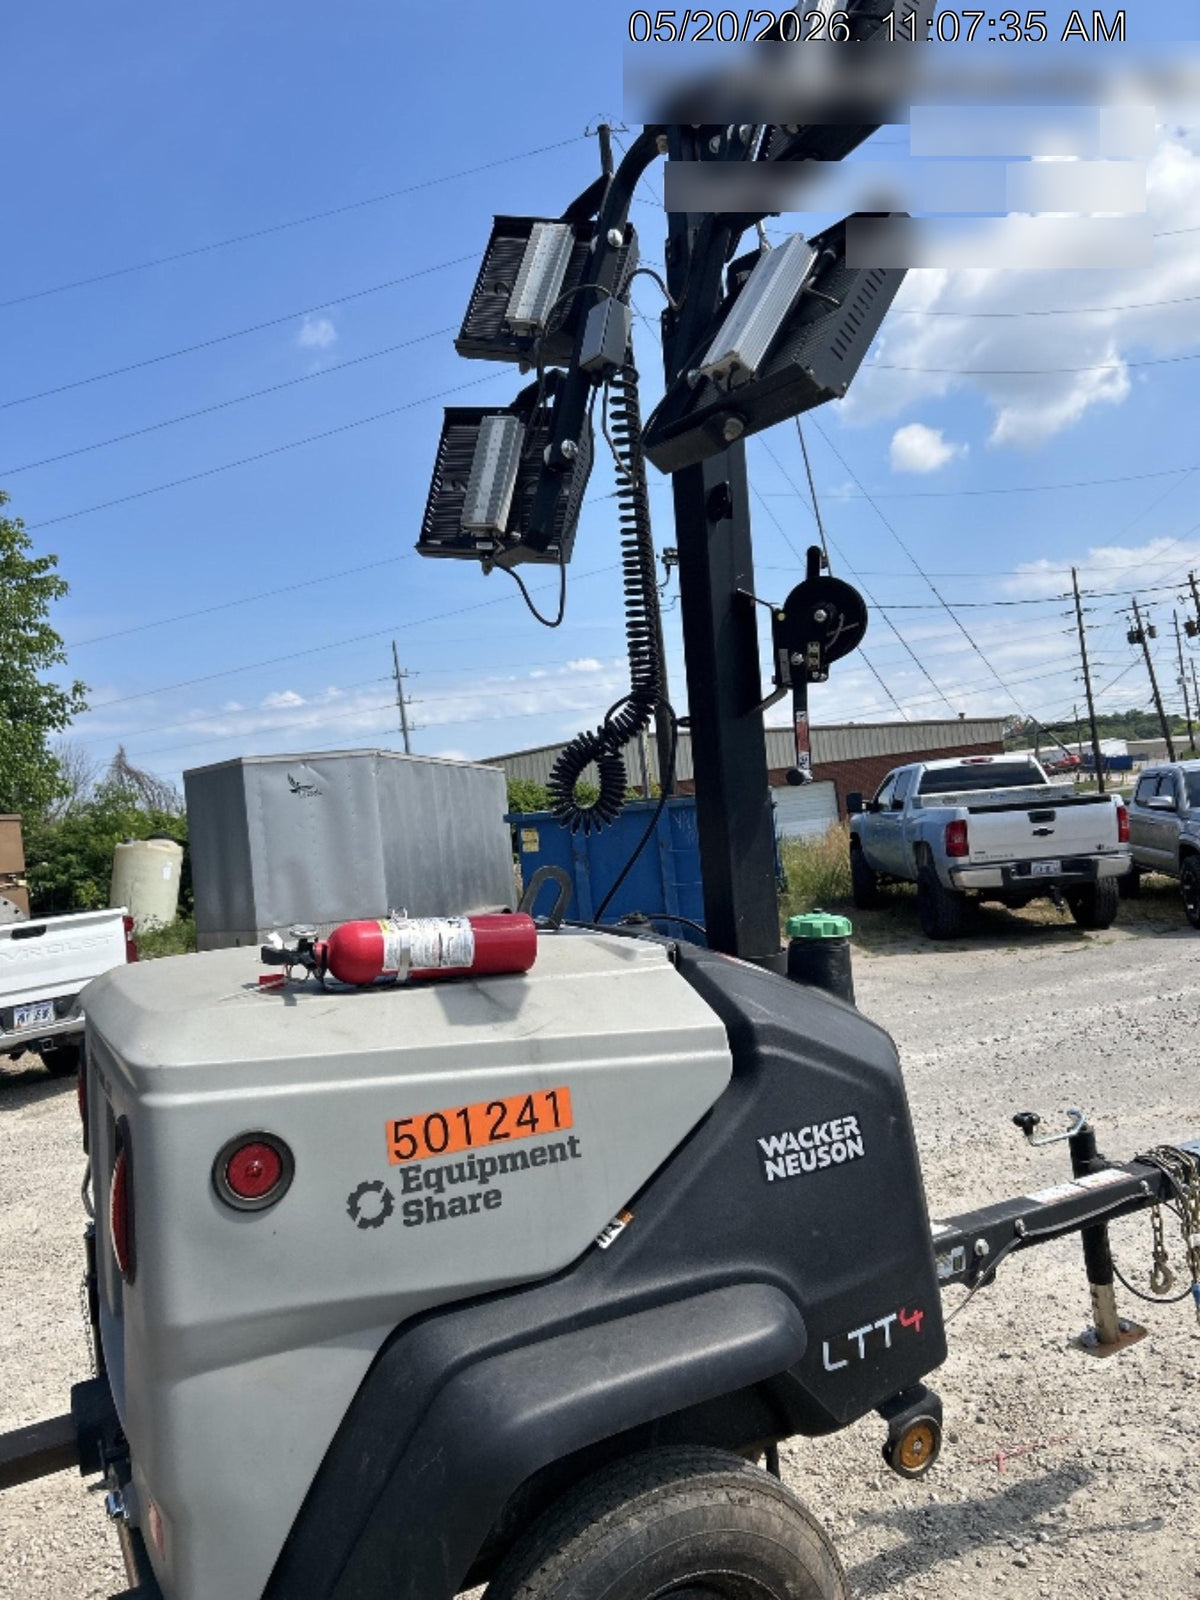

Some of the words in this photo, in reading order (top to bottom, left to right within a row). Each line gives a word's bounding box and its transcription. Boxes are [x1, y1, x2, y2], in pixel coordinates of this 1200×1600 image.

[393, 1090, 562, 1160] 501241
[757, 1115, 861, 1158] WACKER
[400, 1135, 582, 1195] Equipment
[764, 1135, 865, 1181] NEUSON
[402, 1188, 502, 1227] Share
[822, 1307, 923, 1371] LTT4
